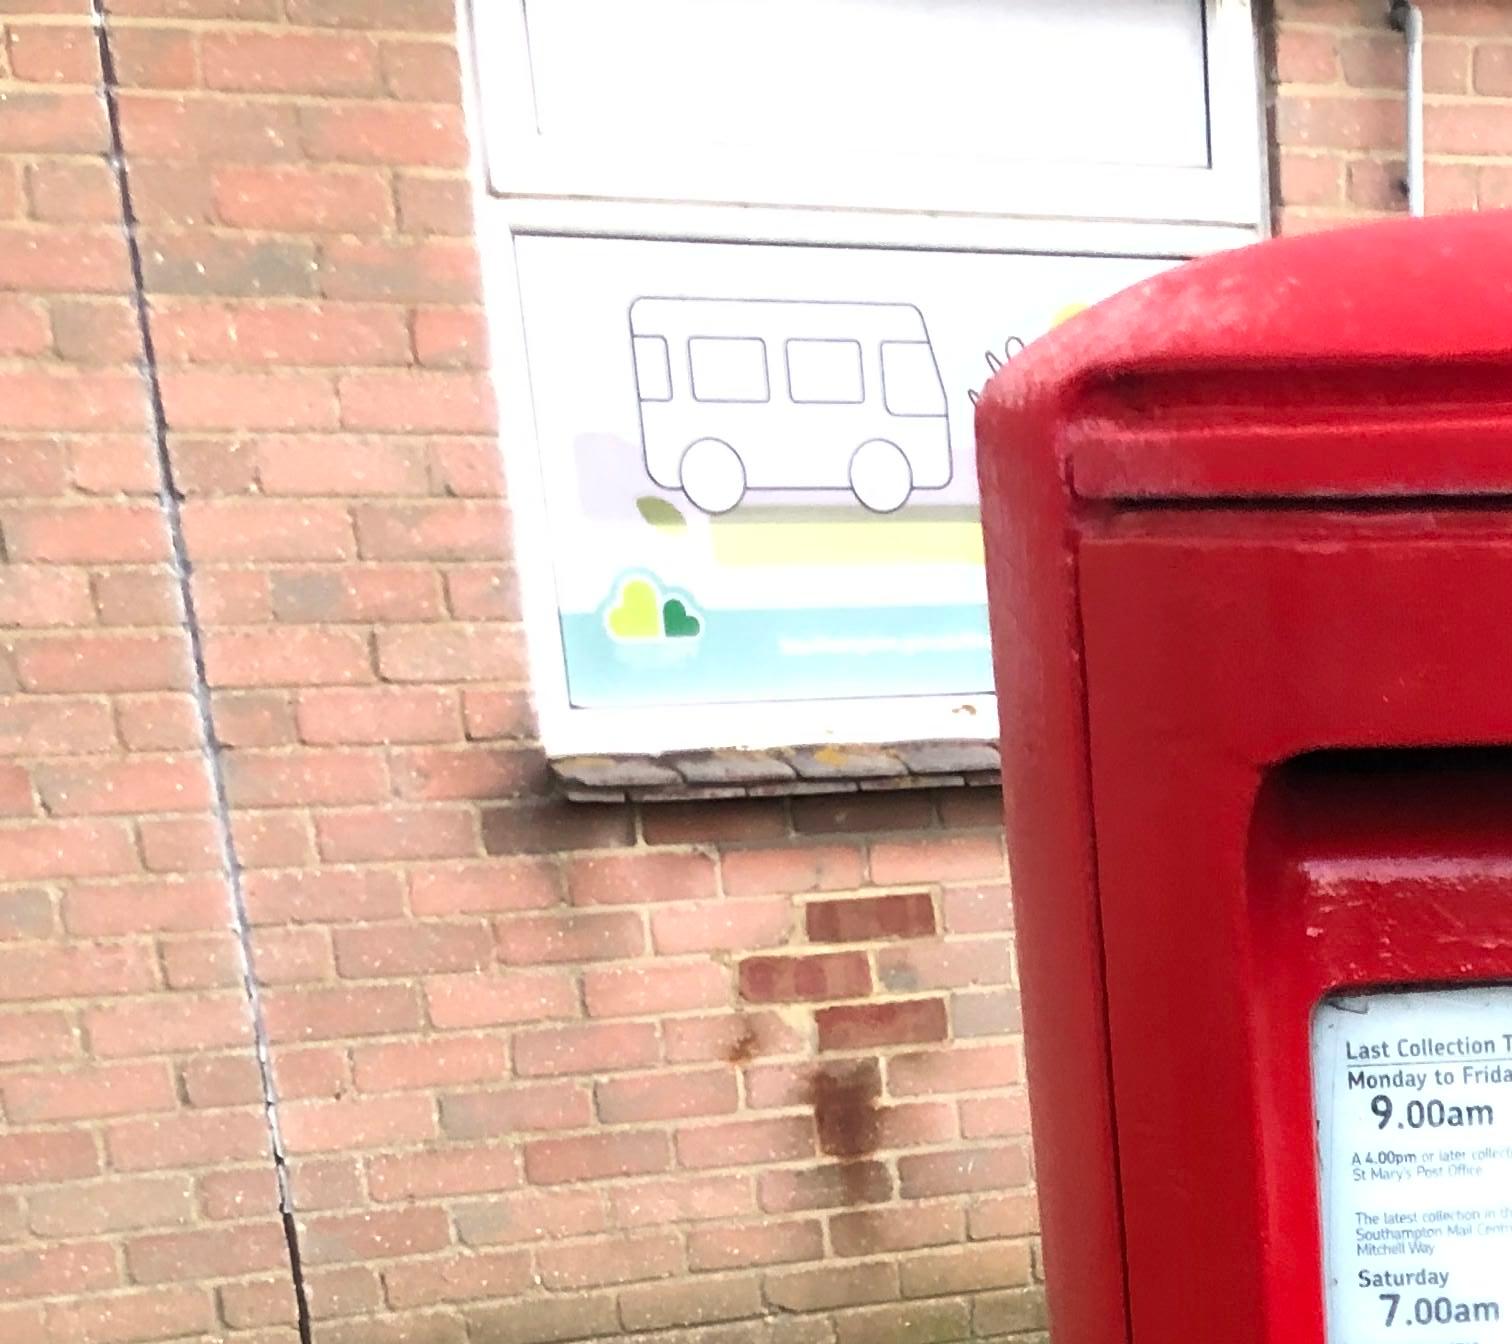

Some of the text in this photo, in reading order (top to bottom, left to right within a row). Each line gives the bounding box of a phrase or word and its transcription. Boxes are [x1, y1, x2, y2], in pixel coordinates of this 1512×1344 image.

[1346, 1040, 1390, 1060] Last
[1397, 1036, 1495, 1058] Collection
[1348, 1069, 1427, 1091] Monday
[1435, 1069, 1454, 1085] to
[1370, 1094, 1494, 1130] 9.00am
[1351, 1152, 1362, 1165] A
[1365, 1150, 1417, 1166] 4.00pm
[1421, 1151, 1435, 1163] or
[1439, 1149, 1467, 1163] later
[1352, 1163, 1483, 1182] St Mary's Post Office
[1355, 1212, 1380, 1225] The
[1384, 1212, 1418, 1225] latest
[1422, 1209, 1481, 1223] collection
[1356, 1226, 1443, 1242] Southampton
[1447, 1224, 1473, 1237] Mail
[1357, 1241, 1435, 1256] Mitchell Way
[1358, 1268, 1449, 1288] Saturday
[1379, 1294, 1500, 1327] 7.00am
